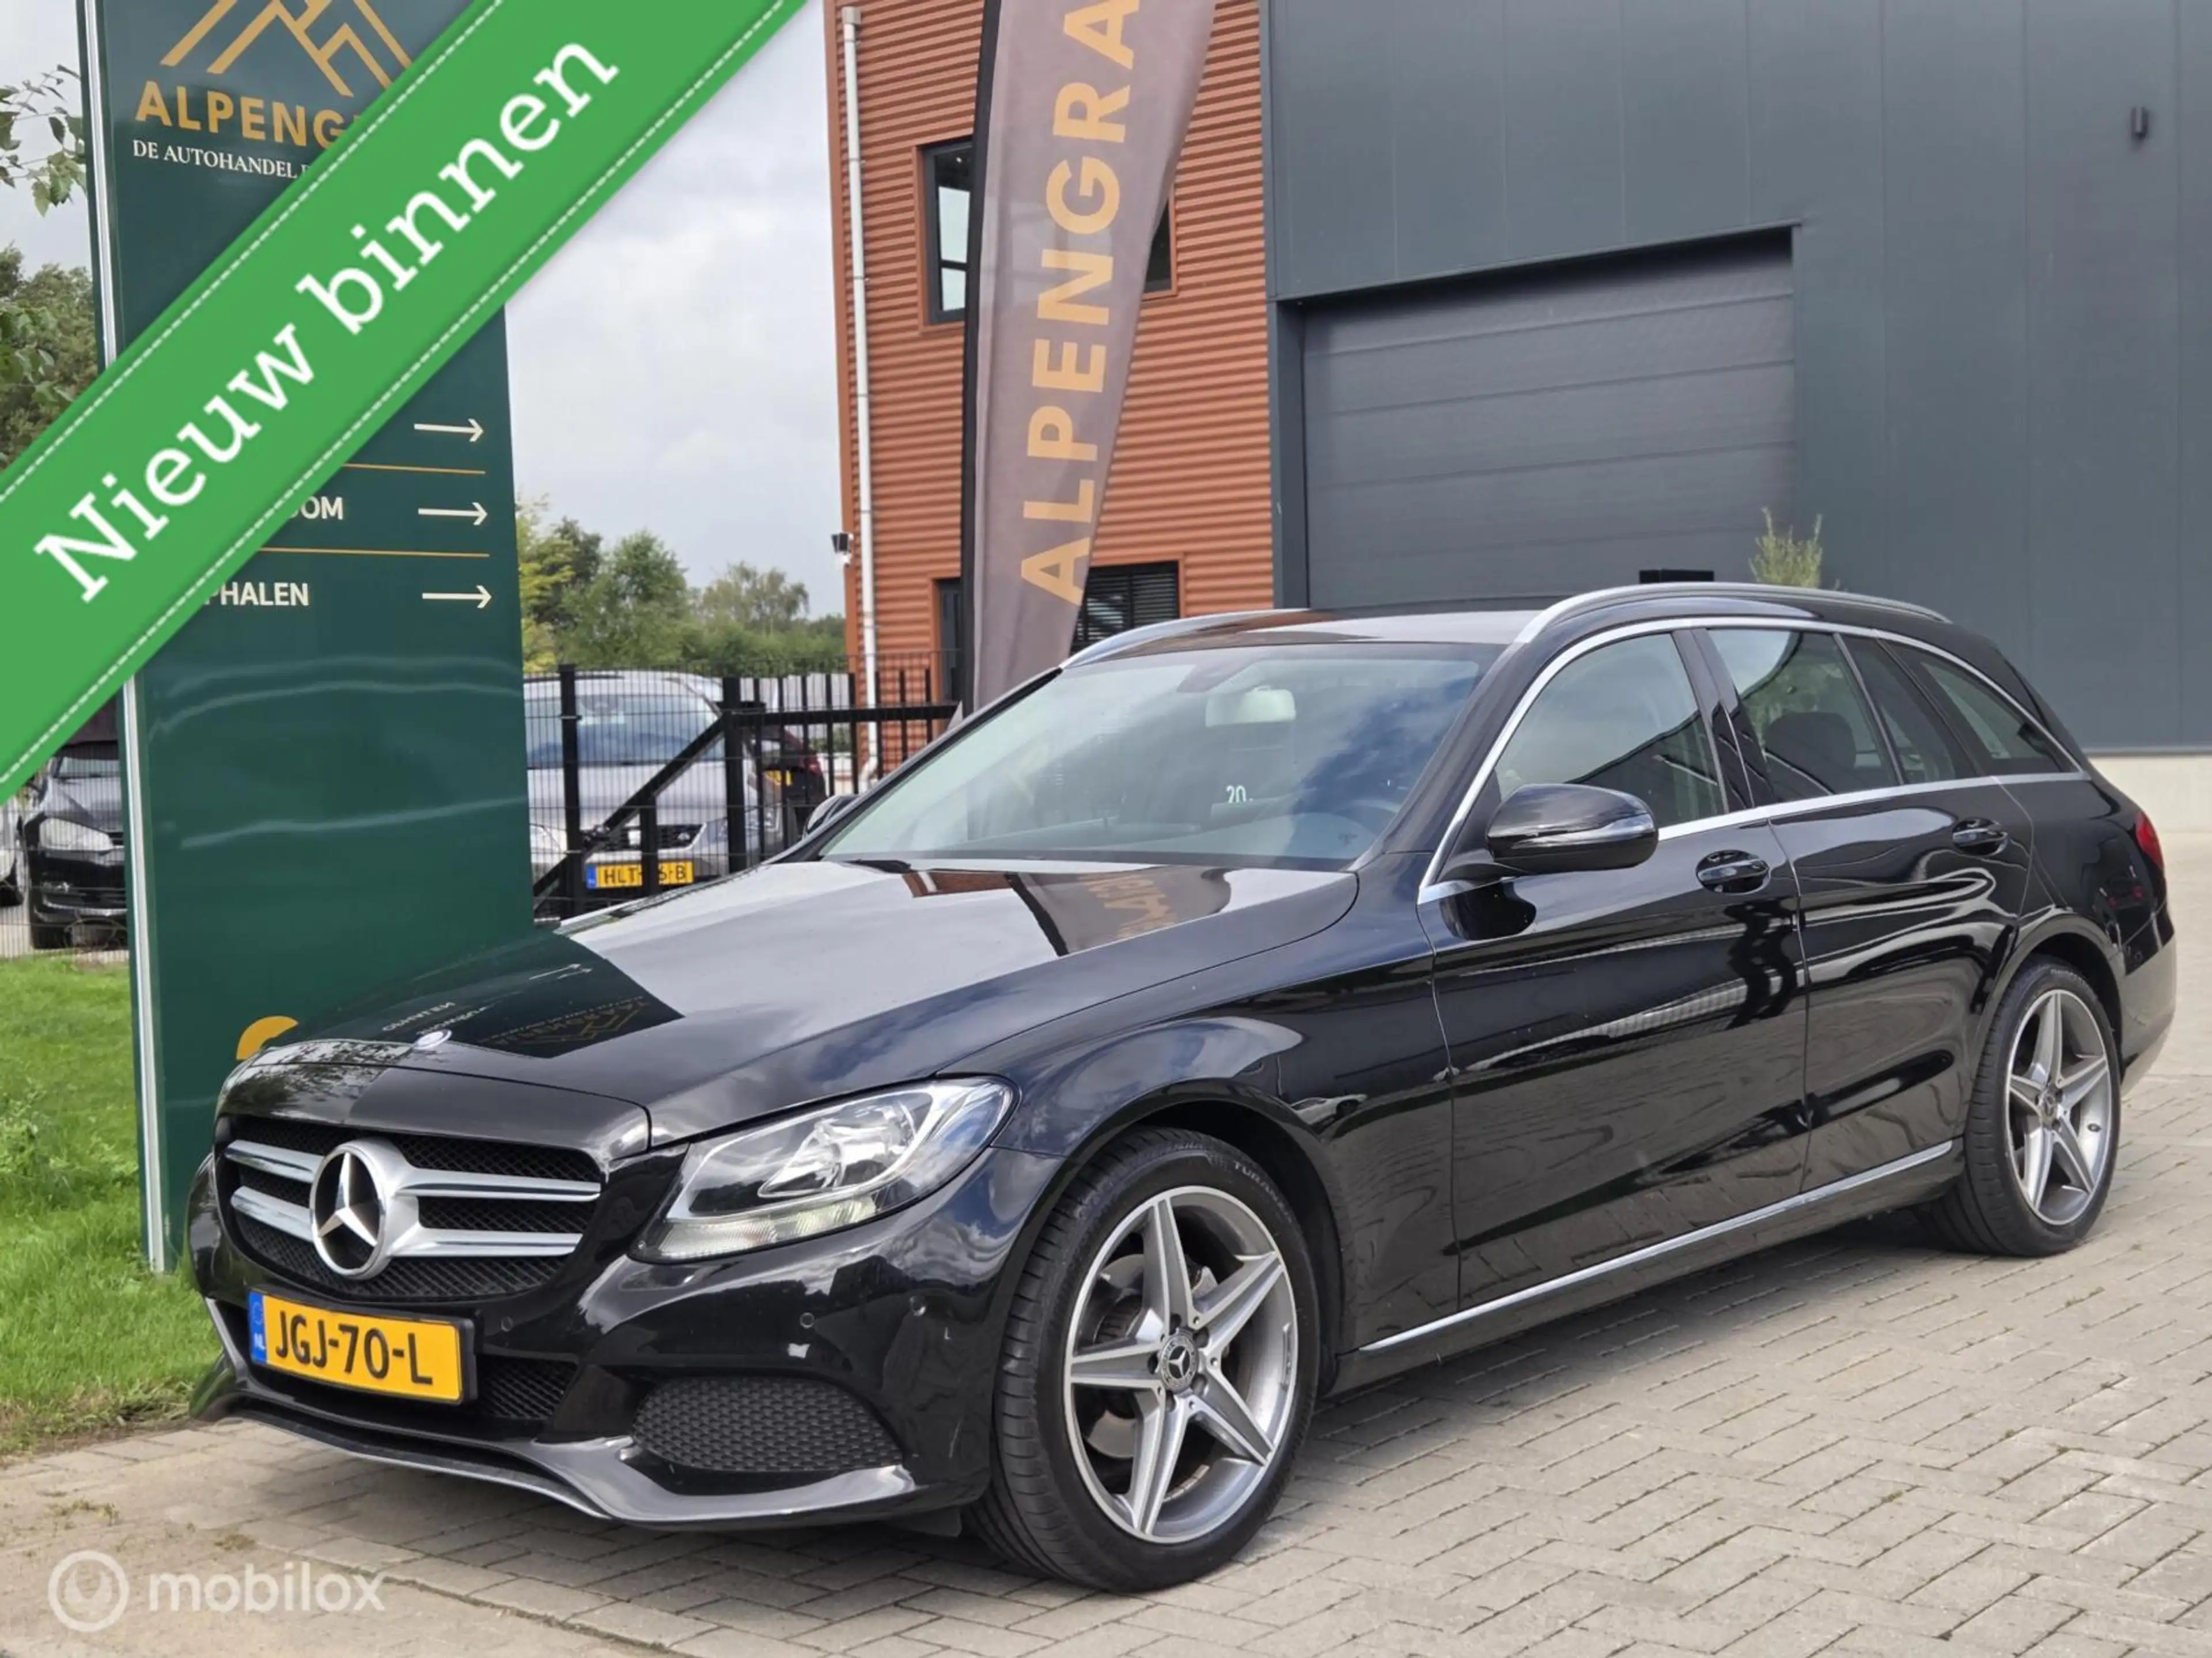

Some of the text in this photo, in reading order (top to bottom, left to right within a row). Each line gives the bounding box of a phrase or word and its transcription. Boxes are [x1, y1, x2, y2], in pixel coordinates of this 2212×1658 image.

[135, 80, 362, 150] ALPENG
[132, 138, 159, 160] DE
[163, 145, 298, 179] AUTOHANDEL
[290, 496, 344, 520] OM
[275, 1310, 433, 1386] JGJ-70-L
